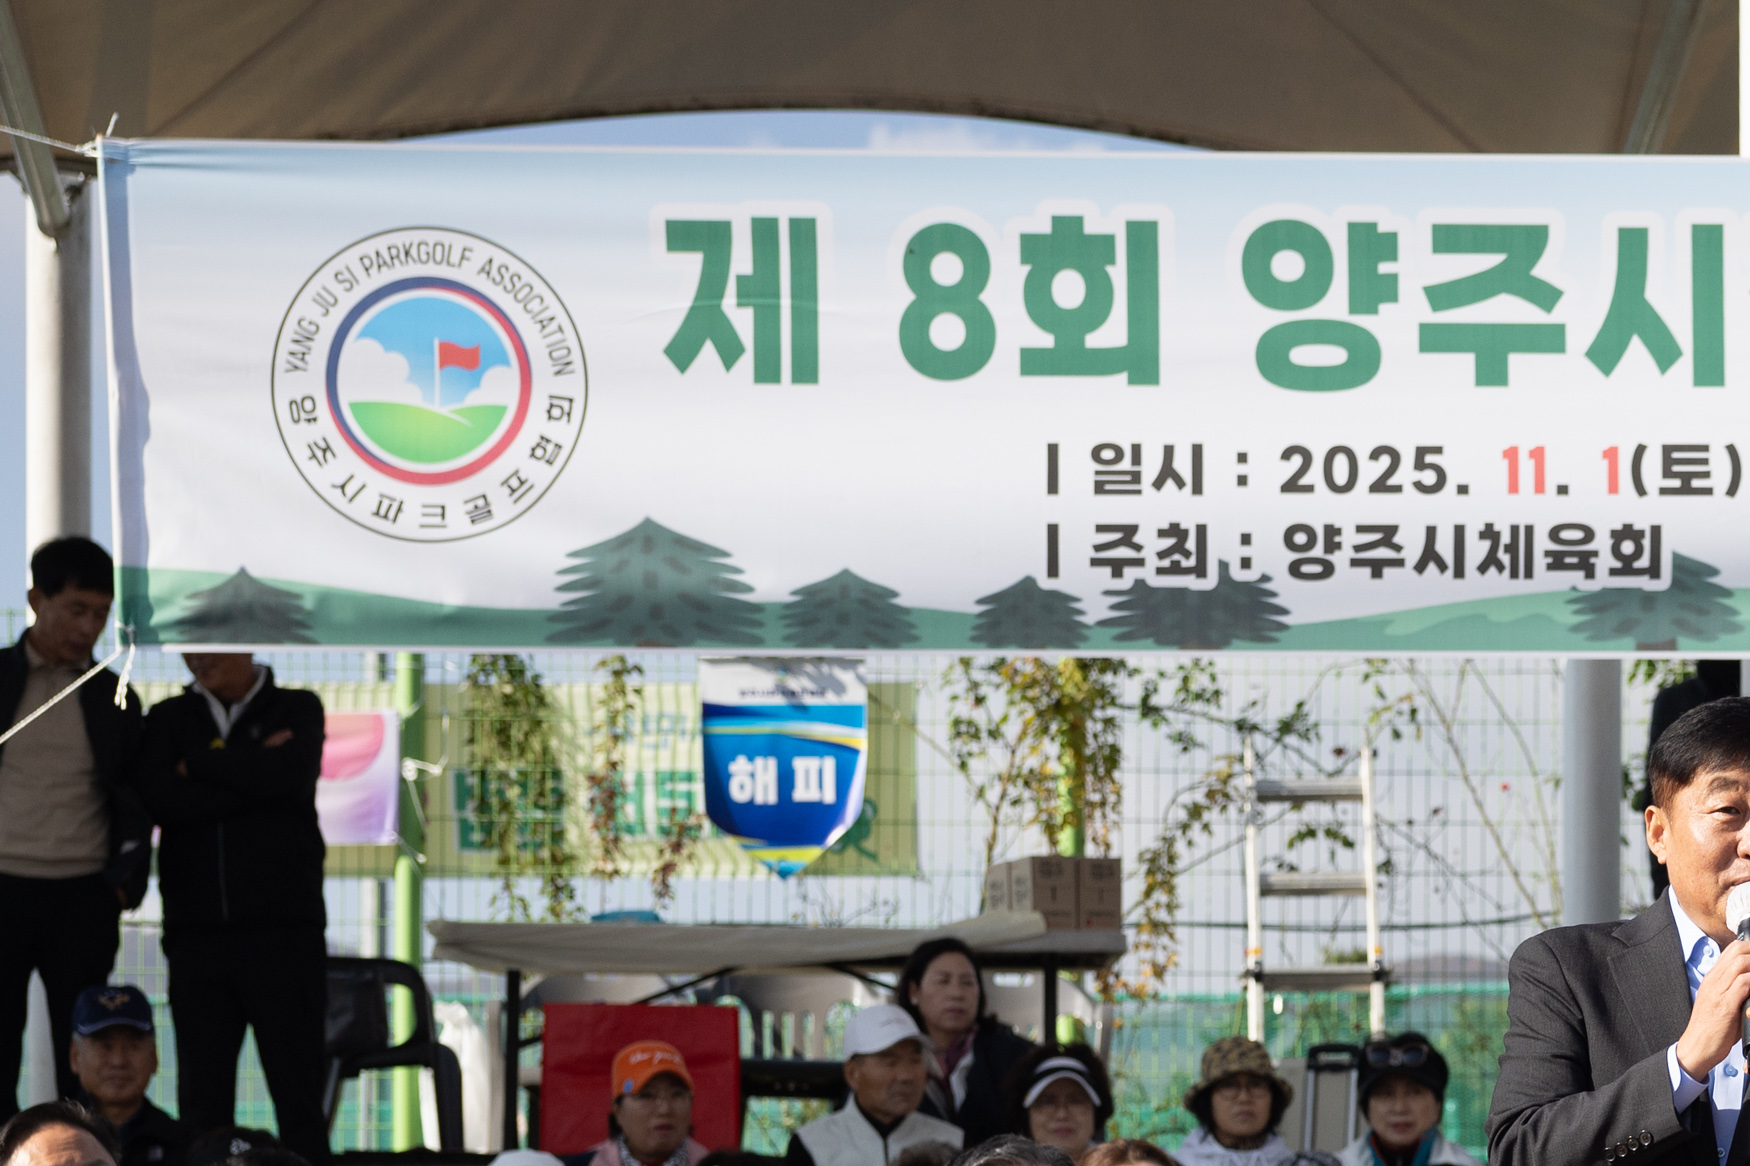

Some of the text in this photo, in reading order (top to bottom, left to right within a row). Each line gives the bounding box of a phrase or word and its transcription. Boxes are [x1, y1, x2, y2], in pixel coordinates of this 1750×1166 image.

[284, 240, 576, 377] YANG JU SI PARKGOLF ASSOCIATION
[664, 216, 819, 385] 제
[898, 215, 1160, 386] 8회
[1090, 442, 1204, 496] 일시
[1279, 445, 1470, 496] 2025.
[1501, 445, 1570, 496] 11.
[1601, 442, 1743, 498] 1(토)
[1089, 521, 1209, 580] 주최
[1282, 521, 1664, 583] 양주시체육회
